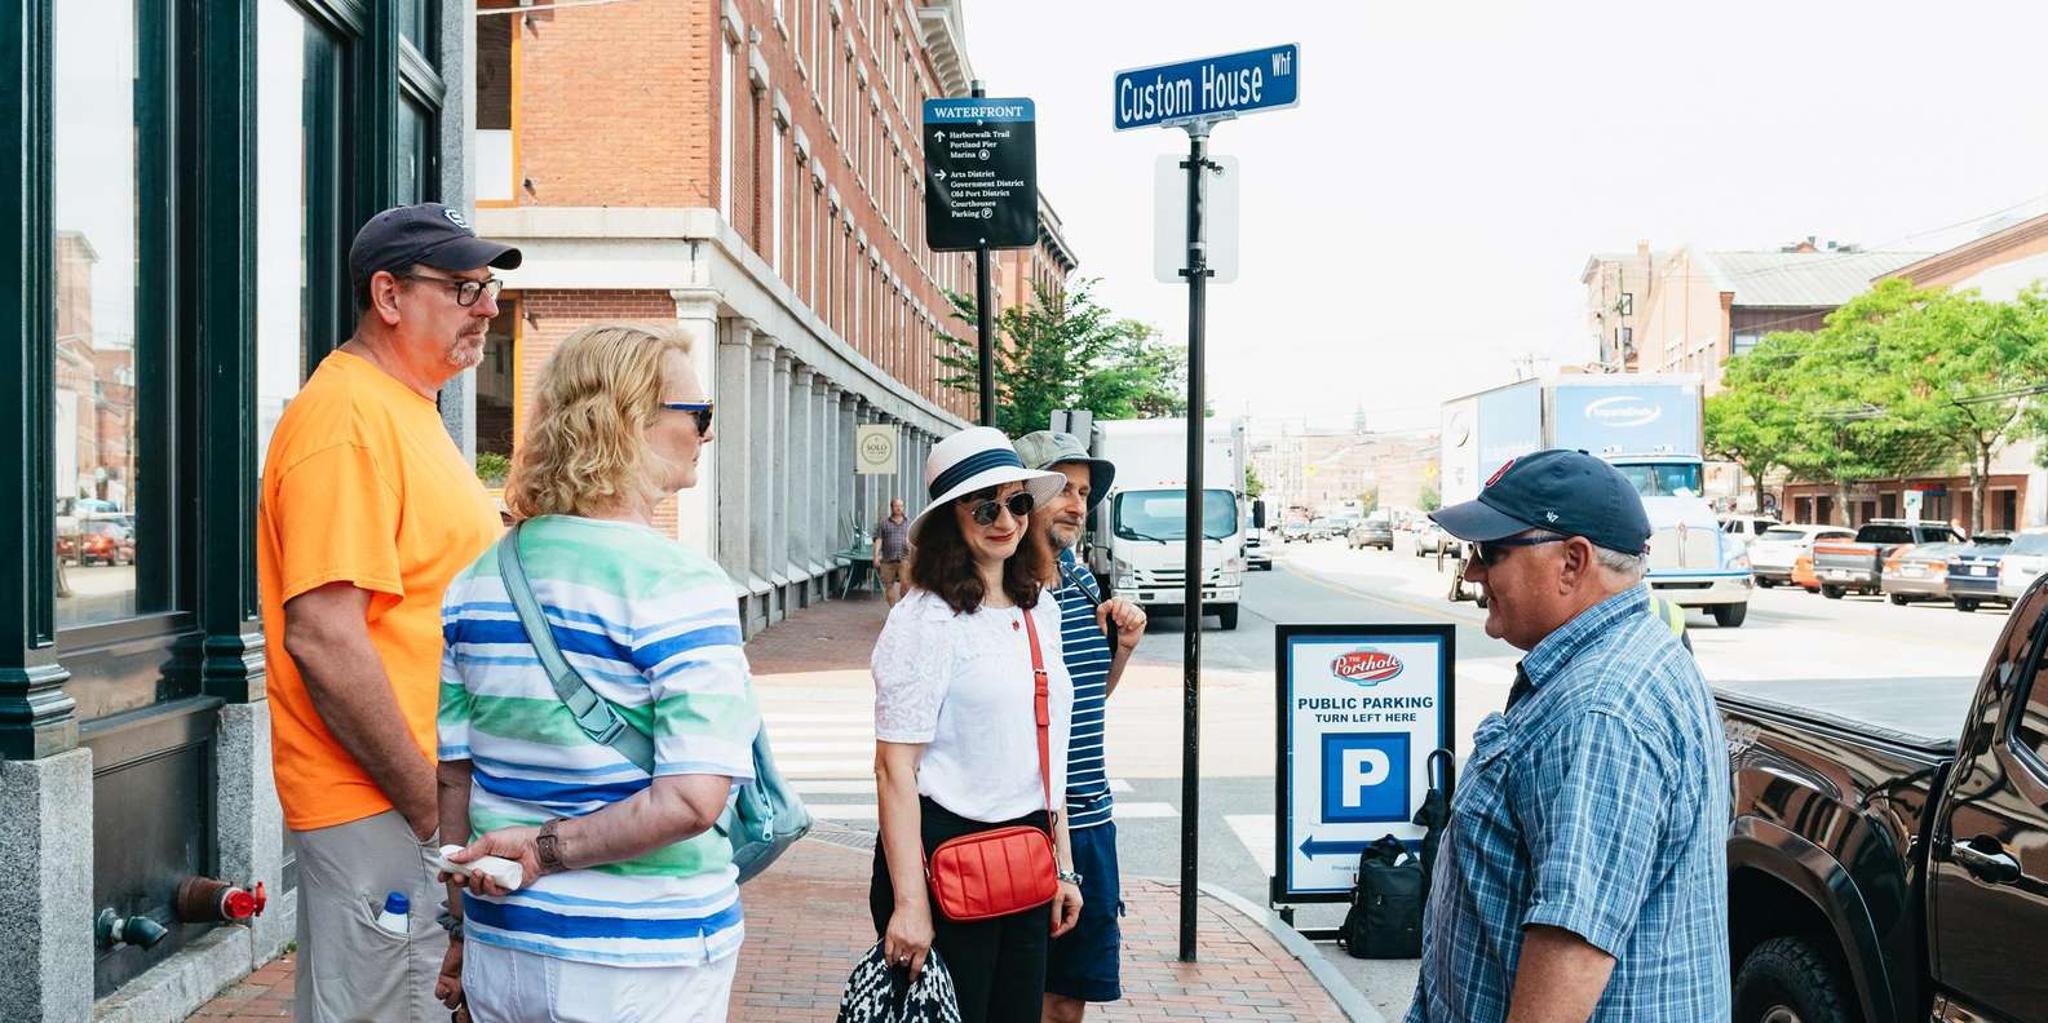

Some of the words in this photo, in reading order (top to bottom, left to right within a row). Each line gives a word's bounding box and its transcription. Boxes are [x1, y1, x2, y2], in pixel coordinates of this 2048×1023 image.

[1120, 74, 1192, 123] Custom
[1202, 64, 1263, 110] House
[1272, 51, 1291, 77] Whf
[934, 106, 1024, 118] WATERFRONT
[952, 210, 980, 218] Parking
[1334, 653, 1399, 675] Porthole
[1298, 697, 1357, 710] PUBLIC
[1363, 696, 1434, 709] PARKING
[1315, 714, 1349, 723] TURN
[1353, 714, 1381, 723] LEFT
[1385, 713, 1417, 722] HERE
[1342, 748, 1390, 808] P
